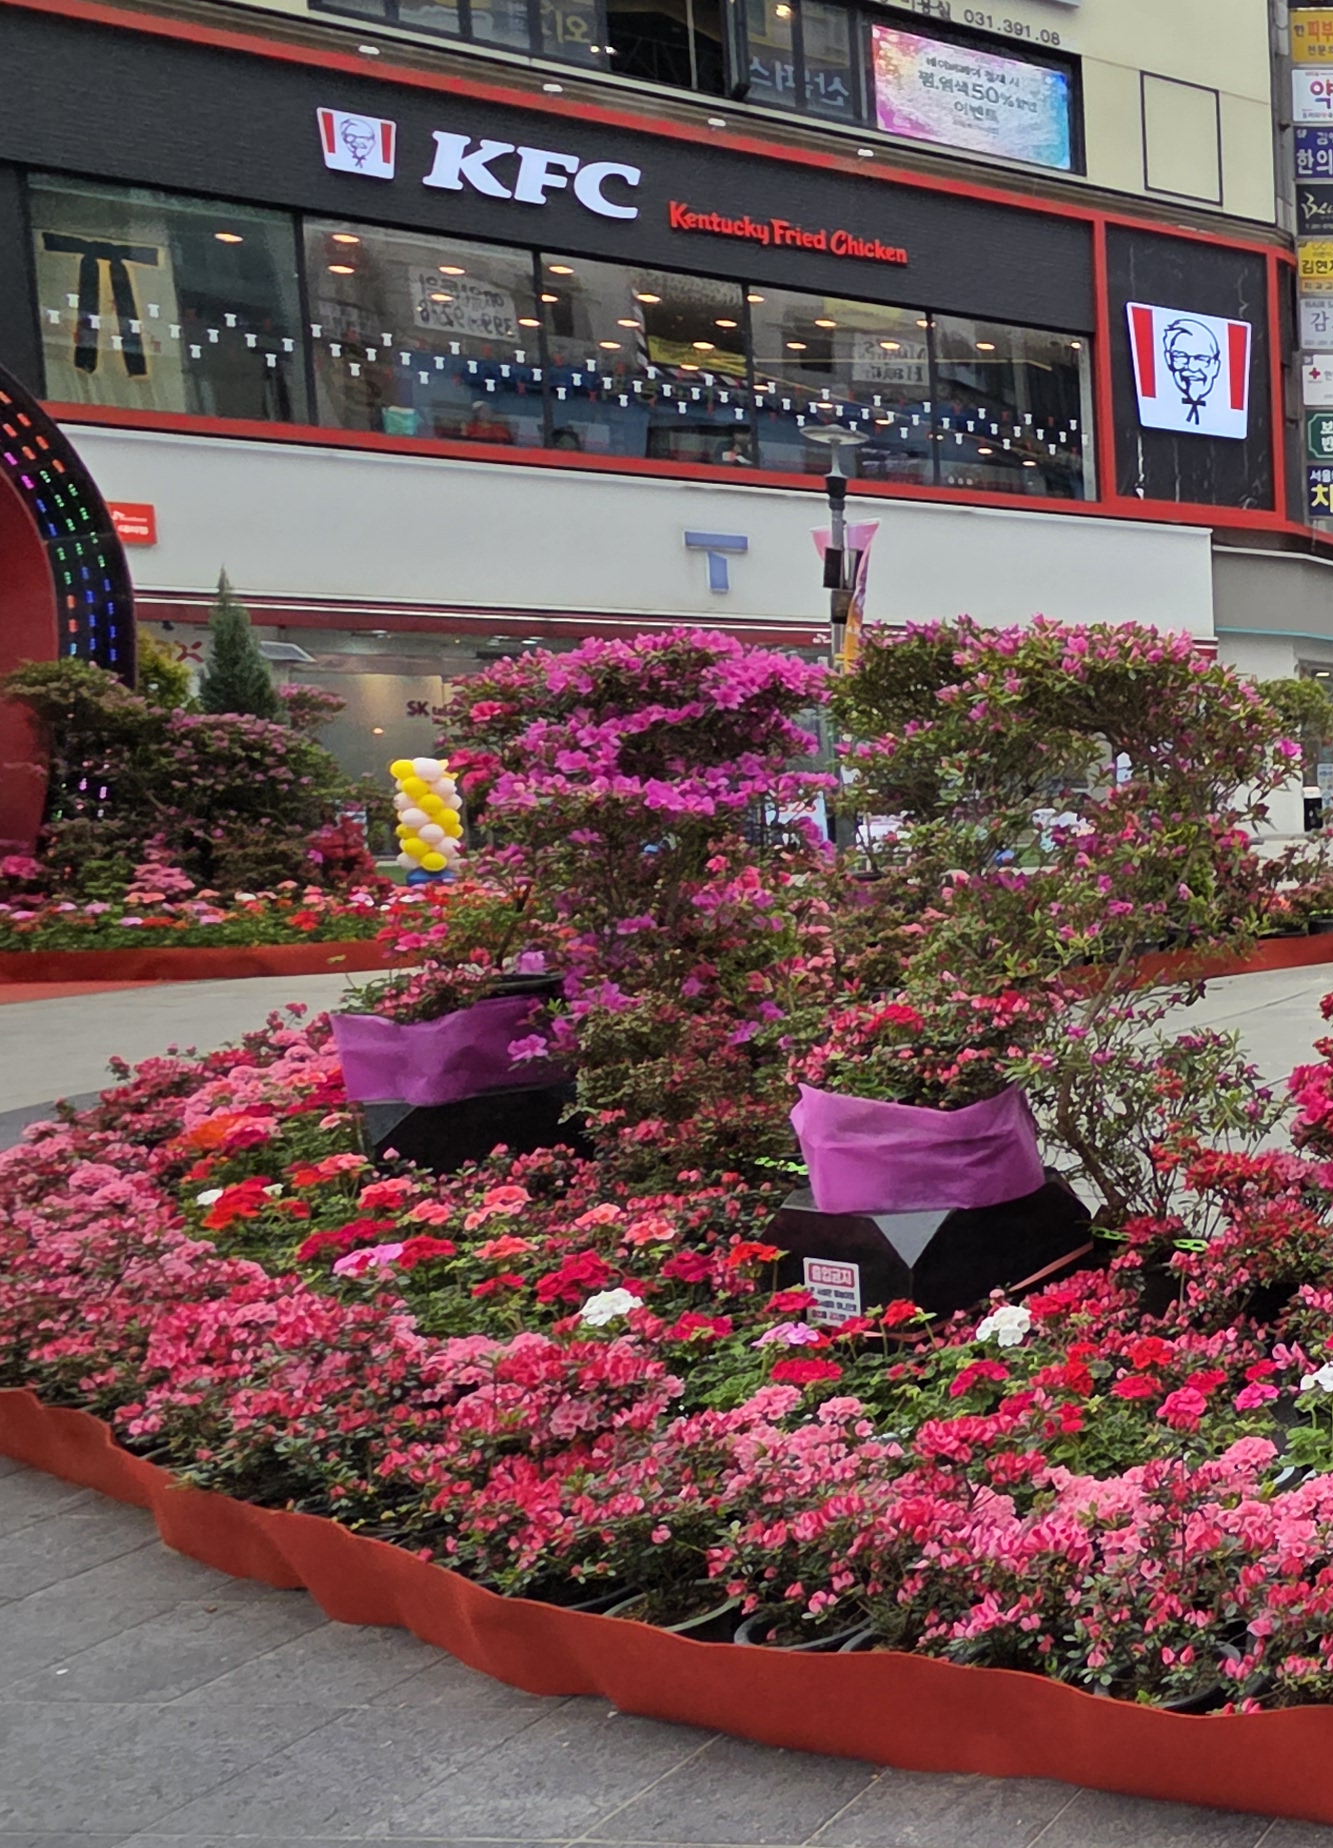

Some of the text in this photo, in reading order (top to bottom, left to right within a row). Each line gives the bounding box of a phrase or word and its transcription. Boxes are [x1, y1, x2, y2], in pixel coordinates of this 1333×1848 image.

[423, 130, 641, 221] KFC
[668, 200, 908, 264] Kentucky Fried Chicken
[407, 700, 430, 716] SK
